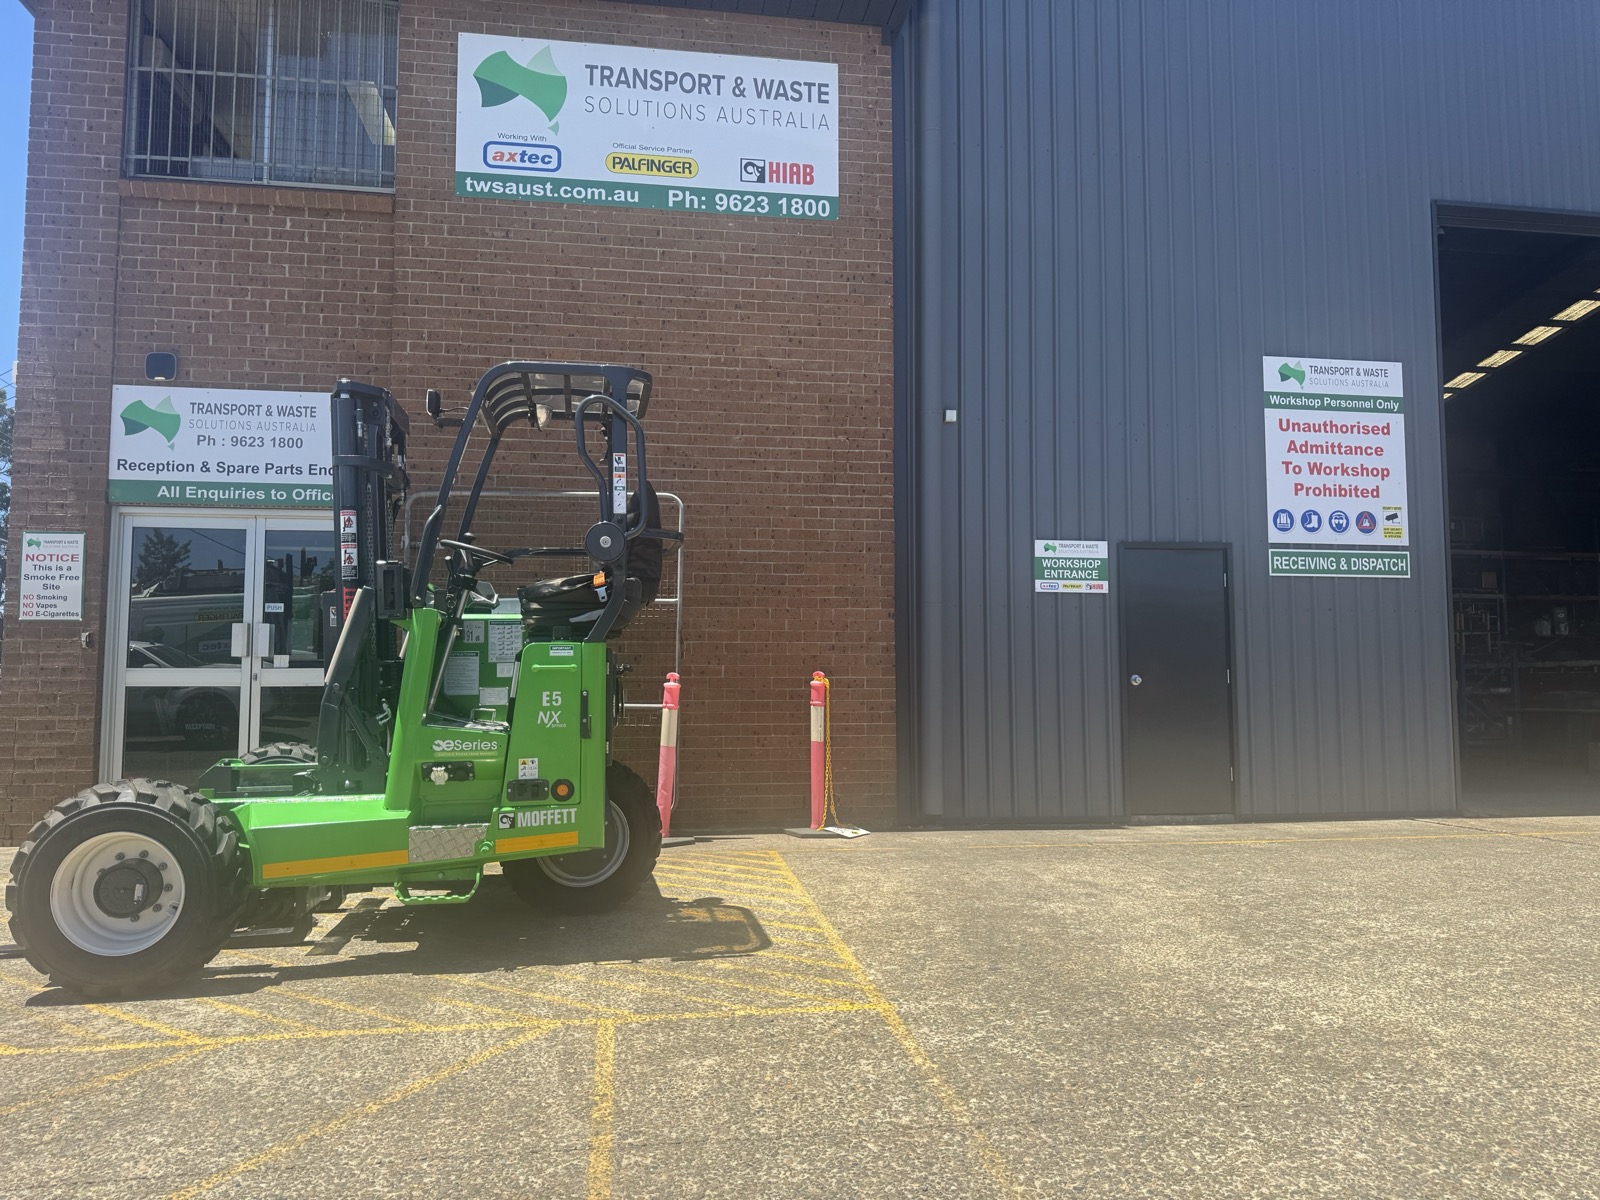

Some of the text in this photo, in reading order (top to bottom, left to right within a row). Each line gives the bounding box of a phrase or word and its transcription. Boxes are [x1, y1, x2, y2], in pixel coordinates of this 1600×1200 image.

[585, 64, 829, 104] TRANSPORT & WASTE
[584, 96, 830, 130] SOLUTIONS AUSTRALIA
[497, 132, 528, 142] Working
[612, 142, 693, 154] Official Service Partner
[492, 150, 553, 165] axtec
[612, 156, 692, 175] PALFINGER
[768, 161, 815, 185] HIAB
[465, 176, 831, 217] twsaust.com.au Ph: 9623 1800
[1309, 365, 1388, 378] TRANSPORT & WASTE
[1309, 378, 1389, 388] SOLUTIONS AUSTRALIA
[190, 402, 317, 418] TRANSPORT & WASTE
[1270, 395, 1399, 412] Workshop Personnel Only
[189, 419, 316, 432] SOLUTIONS AUSTRALIA
[1278, 418, 1391, 436] Unauthorised
[197, 434, 216, 446] Ph
[230, 436, 265, 448] 9623
[270, 437, 303, 448] 1800
[1287, 440, 1384, 457] Admittance
[117, 459, 195, 474] Reception
[200, 461, 211, 473] &
[216, 461, 259, 476] Spare
[265, 462, 303, 475] Parts
[1282, 461, 1390, 481] To Workshop
[157, 486, 334, 501] All Enquiries to Offic
[1294, 482, 1380, 499] Prohibited
[25, 554, 80, 562] NOTICE
[1042, 559, 1101, 568] WORKSHOP
[1273, 556, 1406, 572] RECEIVING & DISPATCH
[1044, 570, 1099, 579] ENTRANCE
[542, 691, 562, 706] E5
[537, 711, 562, 728] NX
[518, 808, 577, 828] MOFFETT
